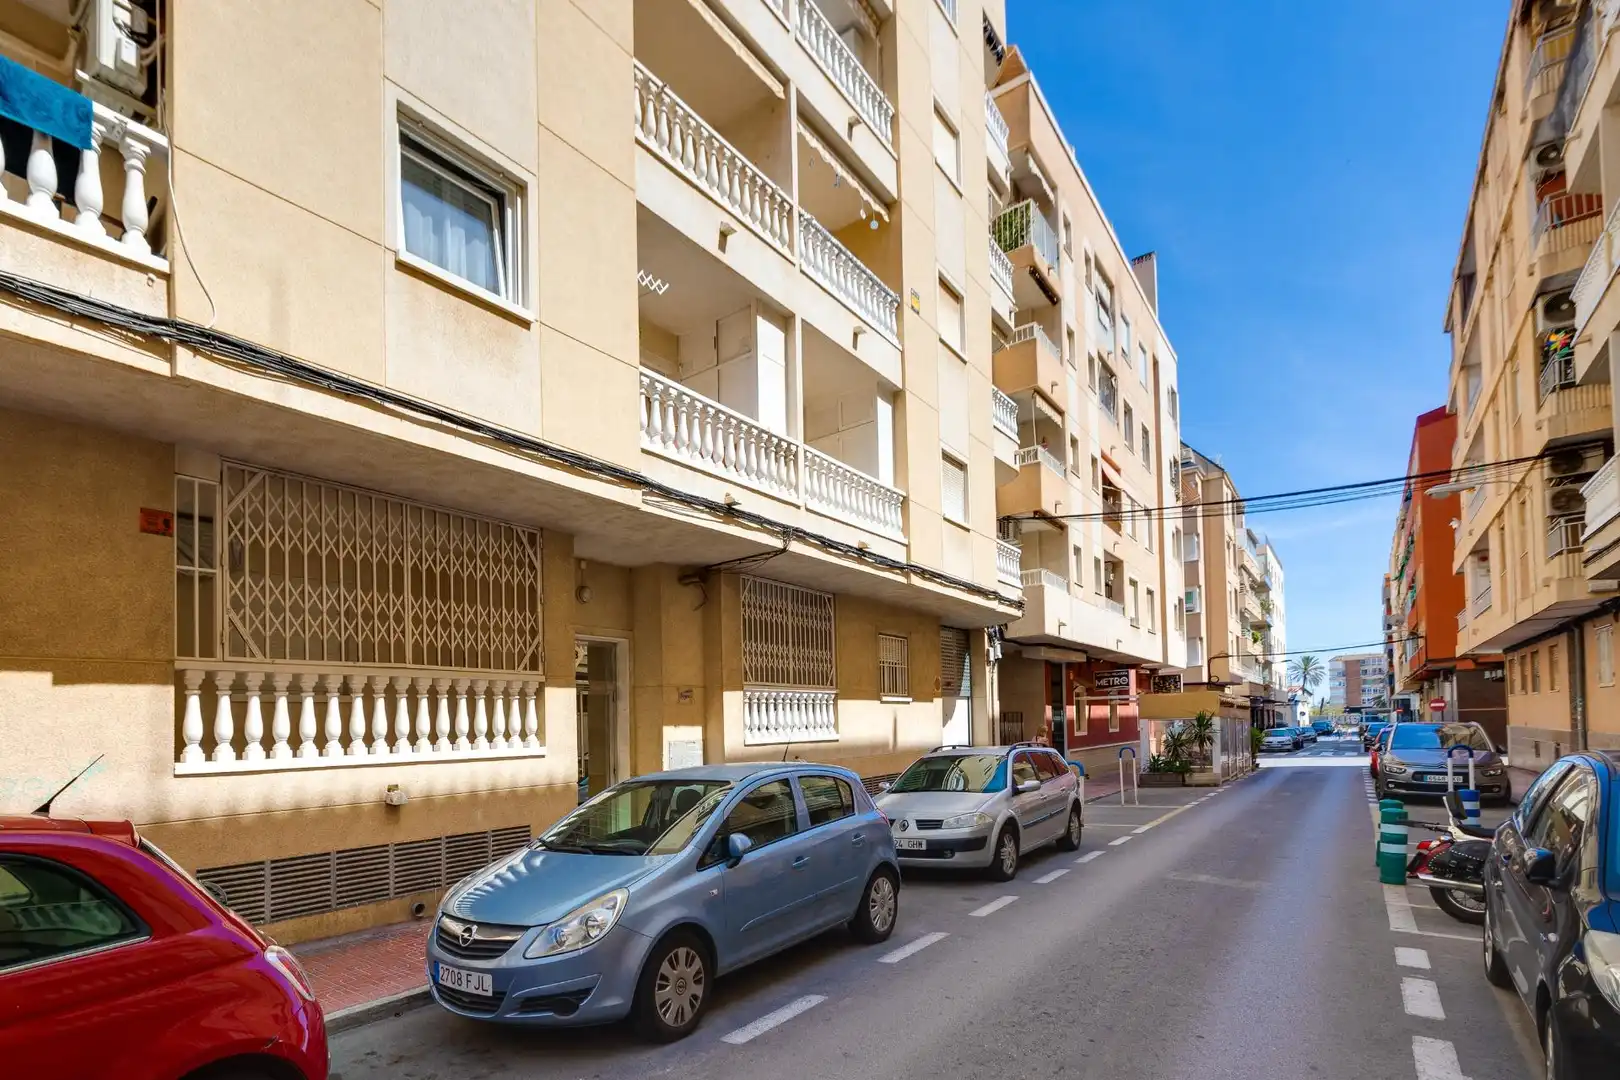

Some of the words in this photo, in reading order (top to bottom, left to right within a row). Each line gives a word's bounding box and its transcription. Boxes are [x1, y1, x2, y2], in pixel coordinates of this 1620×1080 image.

[1095, 676, 1128, 687] METRO
[440, 966, 463, 987] 2708
[466, 973, 489, 993] FJL
